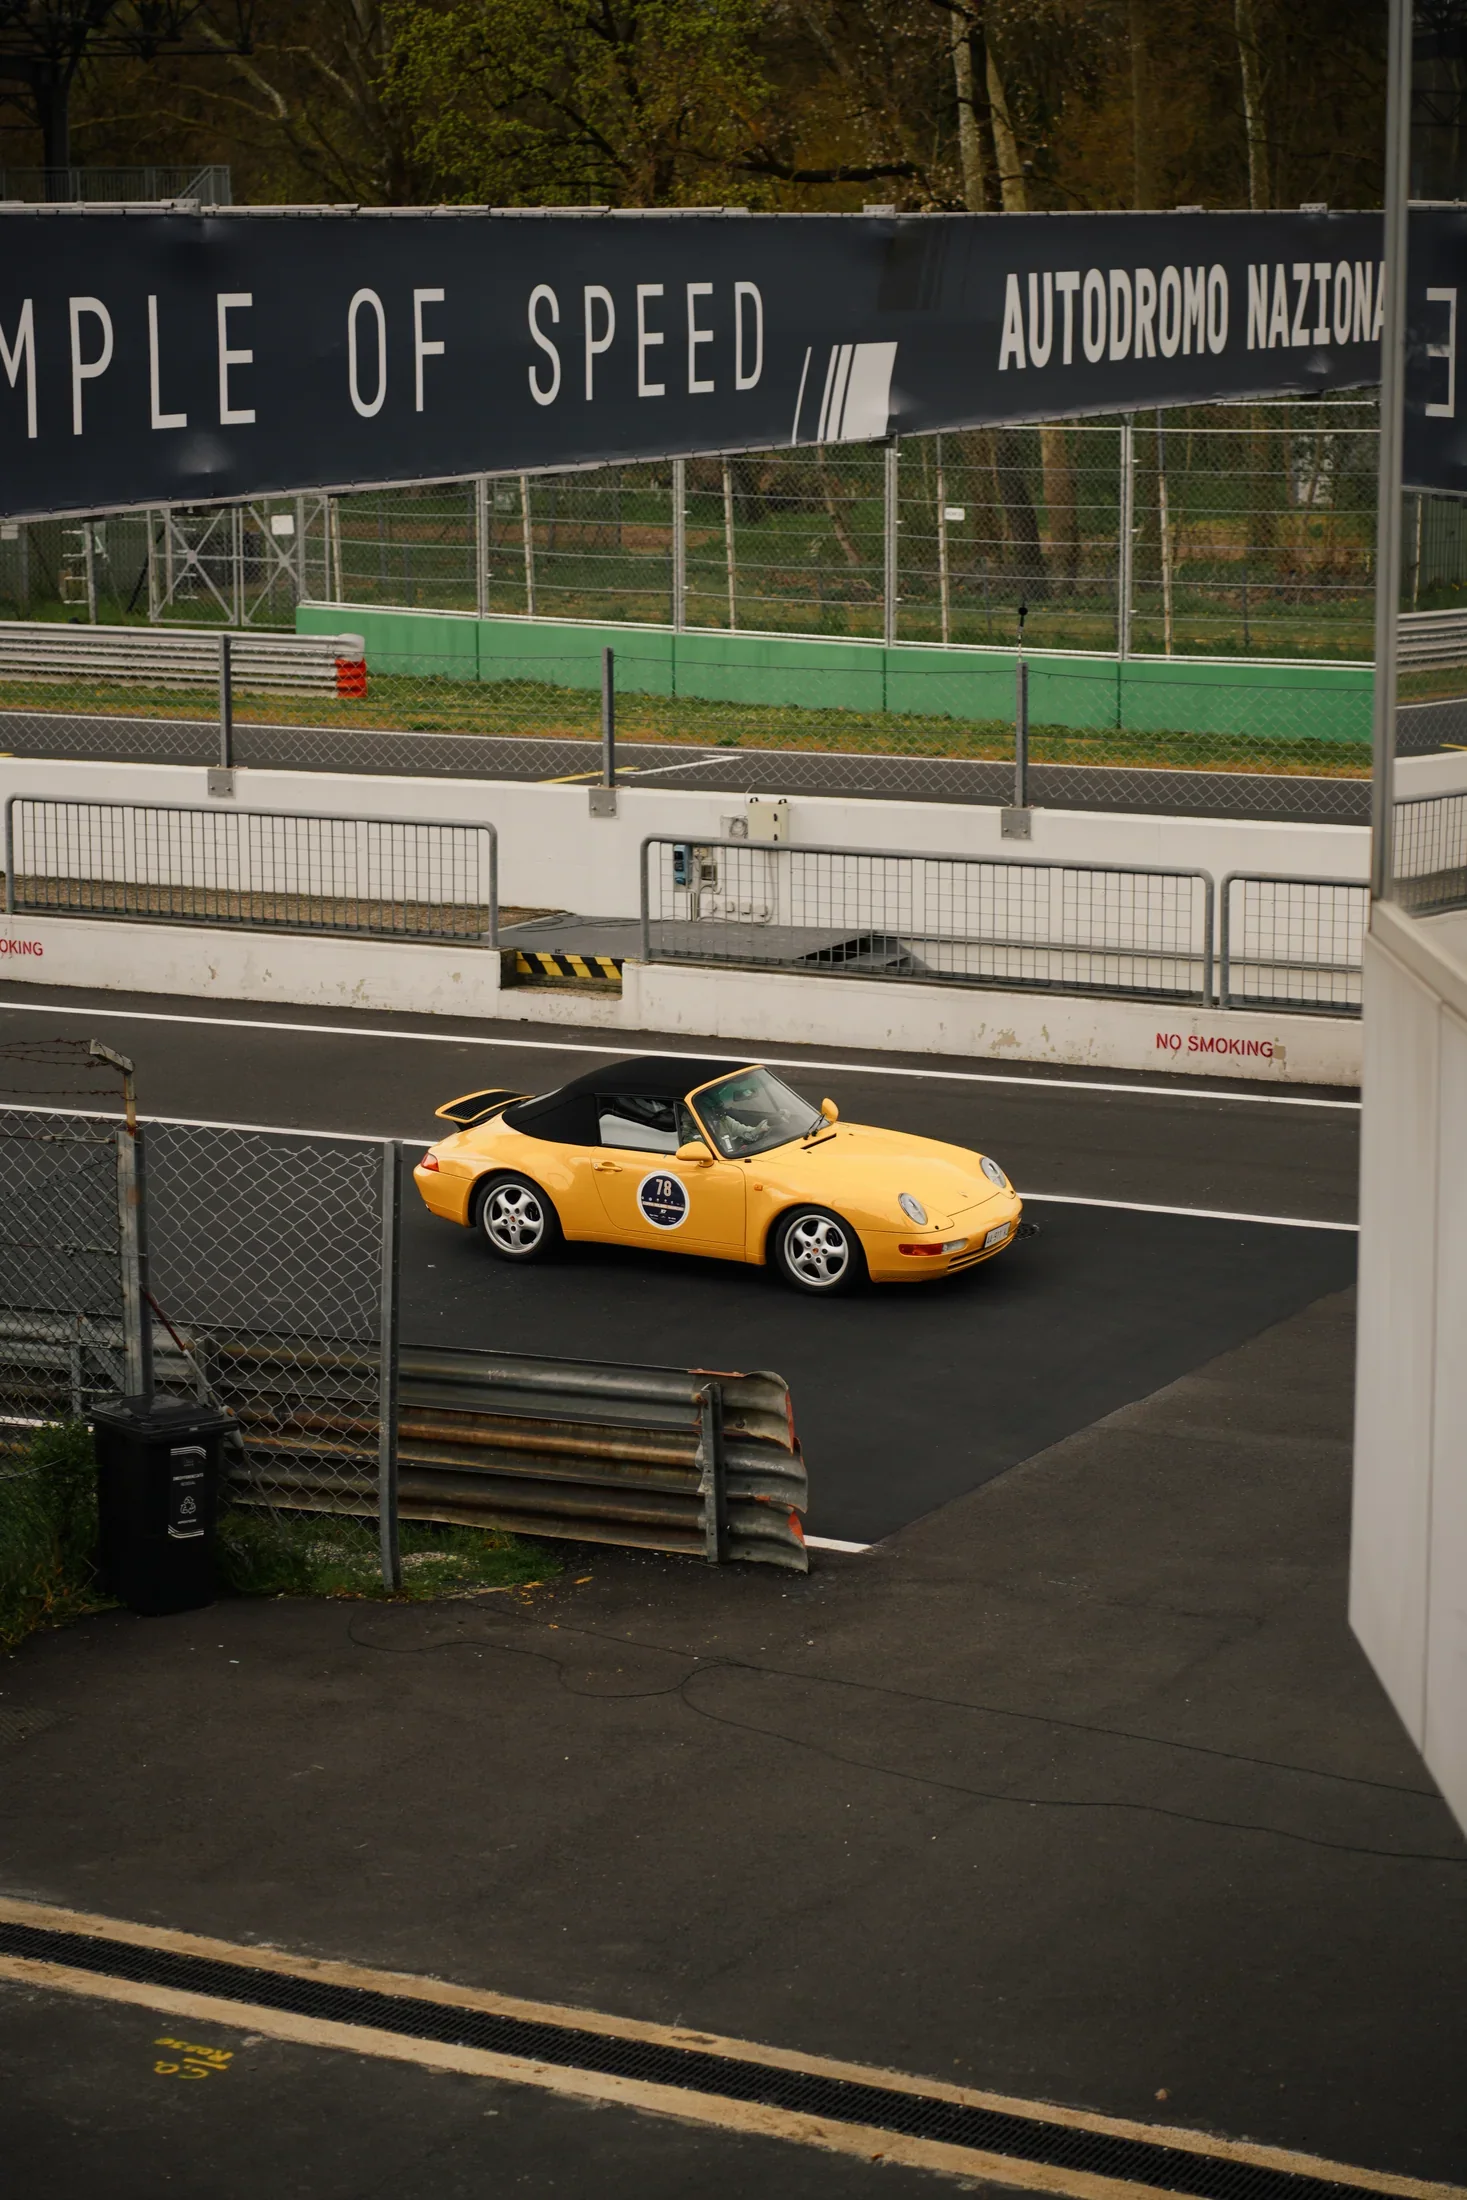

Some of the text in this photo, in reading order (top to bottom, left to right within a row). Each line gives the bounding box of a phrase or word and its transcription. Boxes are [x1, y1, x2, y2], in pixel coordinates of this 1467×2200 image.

[998, 263, 1229, 371] AUTODROMO
[0, 281, 763, 438] MPLE OF SPEED
[0, 938, 44, 957] OKING
[1156, 1032, 1274, 1058] NO SMOKING
[655, 1178, 672, 1197] 78
